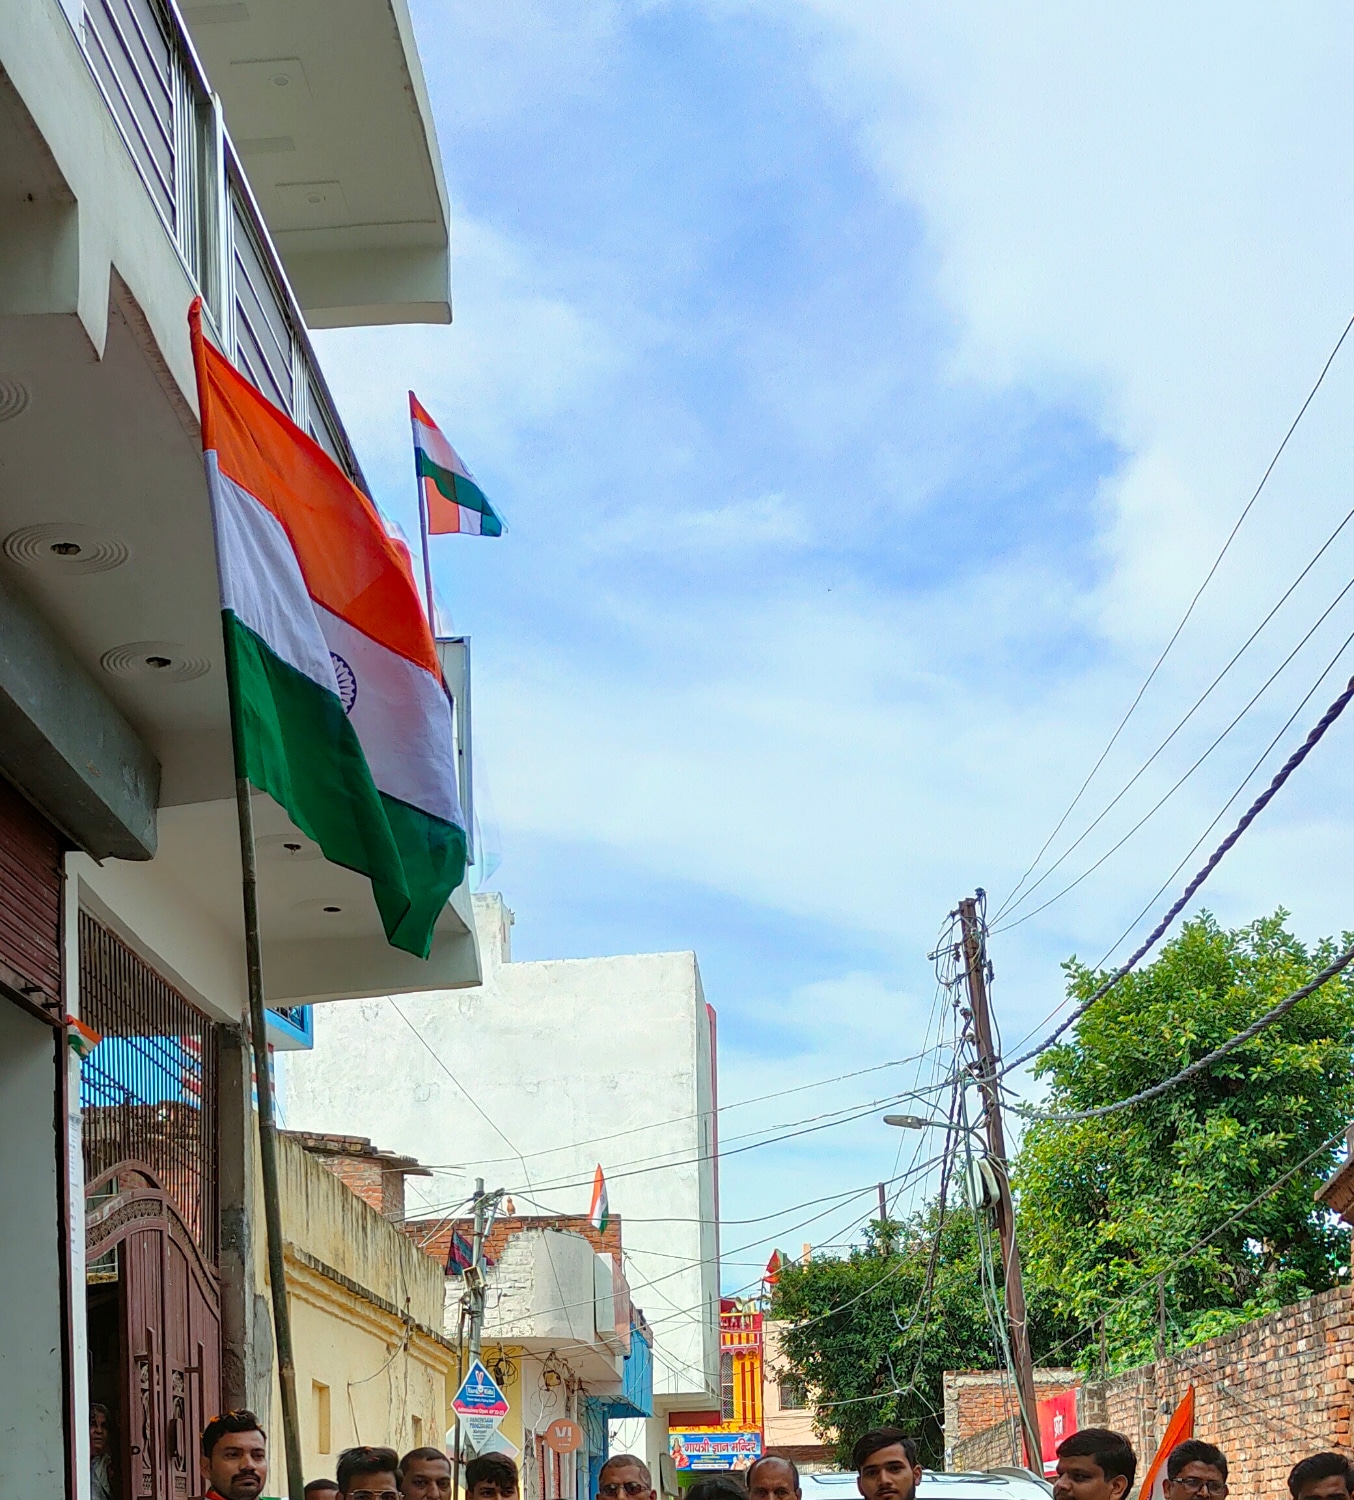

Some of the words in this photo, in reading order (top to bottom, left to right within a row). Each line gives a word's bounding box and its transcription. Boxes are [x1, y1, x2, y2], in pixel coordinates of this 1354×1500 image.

[684, 1437, 710, 1453] गायत्री
[712, 1441, 729, 1455] ज्ञान
[731, 1437, 756, 1453] मन्दिर
